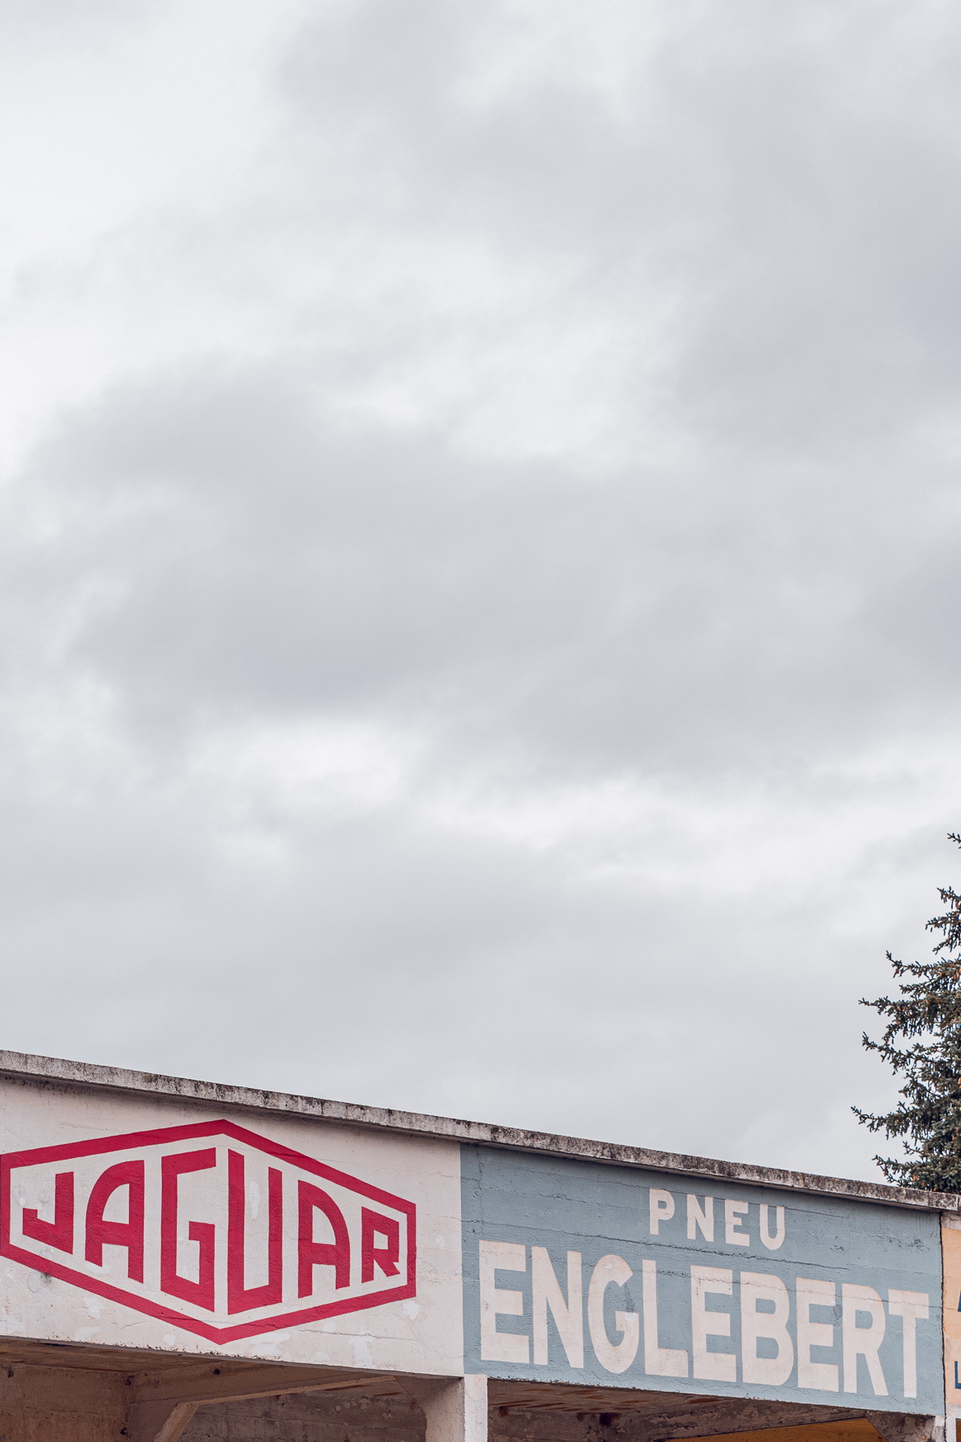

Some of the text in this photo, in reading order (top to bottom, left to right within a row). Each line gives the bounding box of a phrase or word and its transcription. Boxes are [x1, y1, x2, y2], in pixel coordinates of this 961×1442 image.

[22, 1146, 401, 1316] JAGUAR
[648, 1187, 786, 1251] PNEU
[478, 1239, 930, 1399] ENGLEBERT
